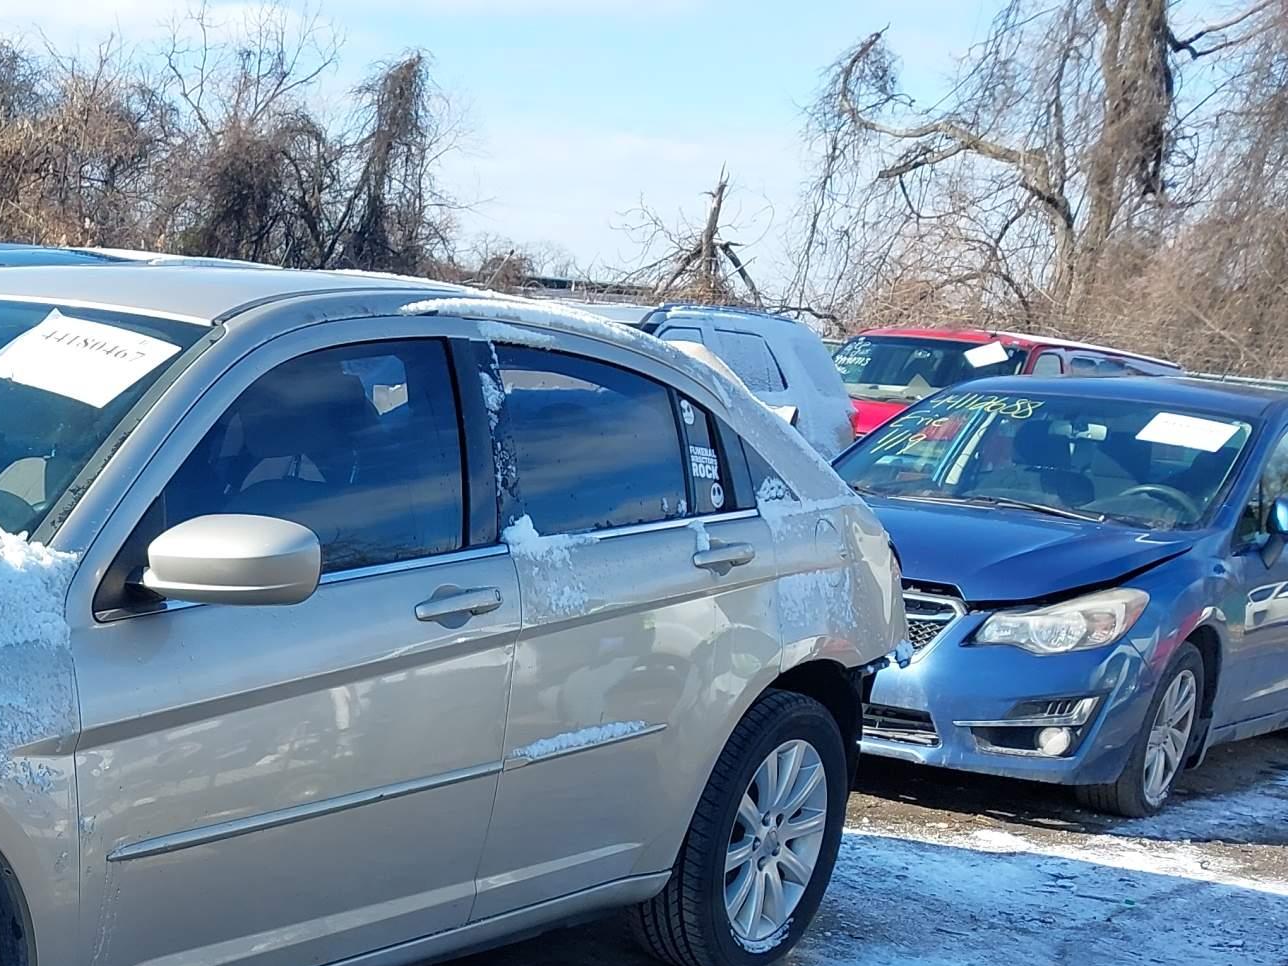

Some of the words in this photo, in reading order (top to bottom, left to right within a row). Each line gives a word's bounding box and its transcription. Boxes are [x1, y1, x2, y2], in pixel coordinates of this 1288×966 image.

[41, 330, 146, 362] 44180467
[890, 410, 949, 428] Eric
[689, 445, 717, 458] FUNERAL
[692, 462, 720, 481] ROCK
